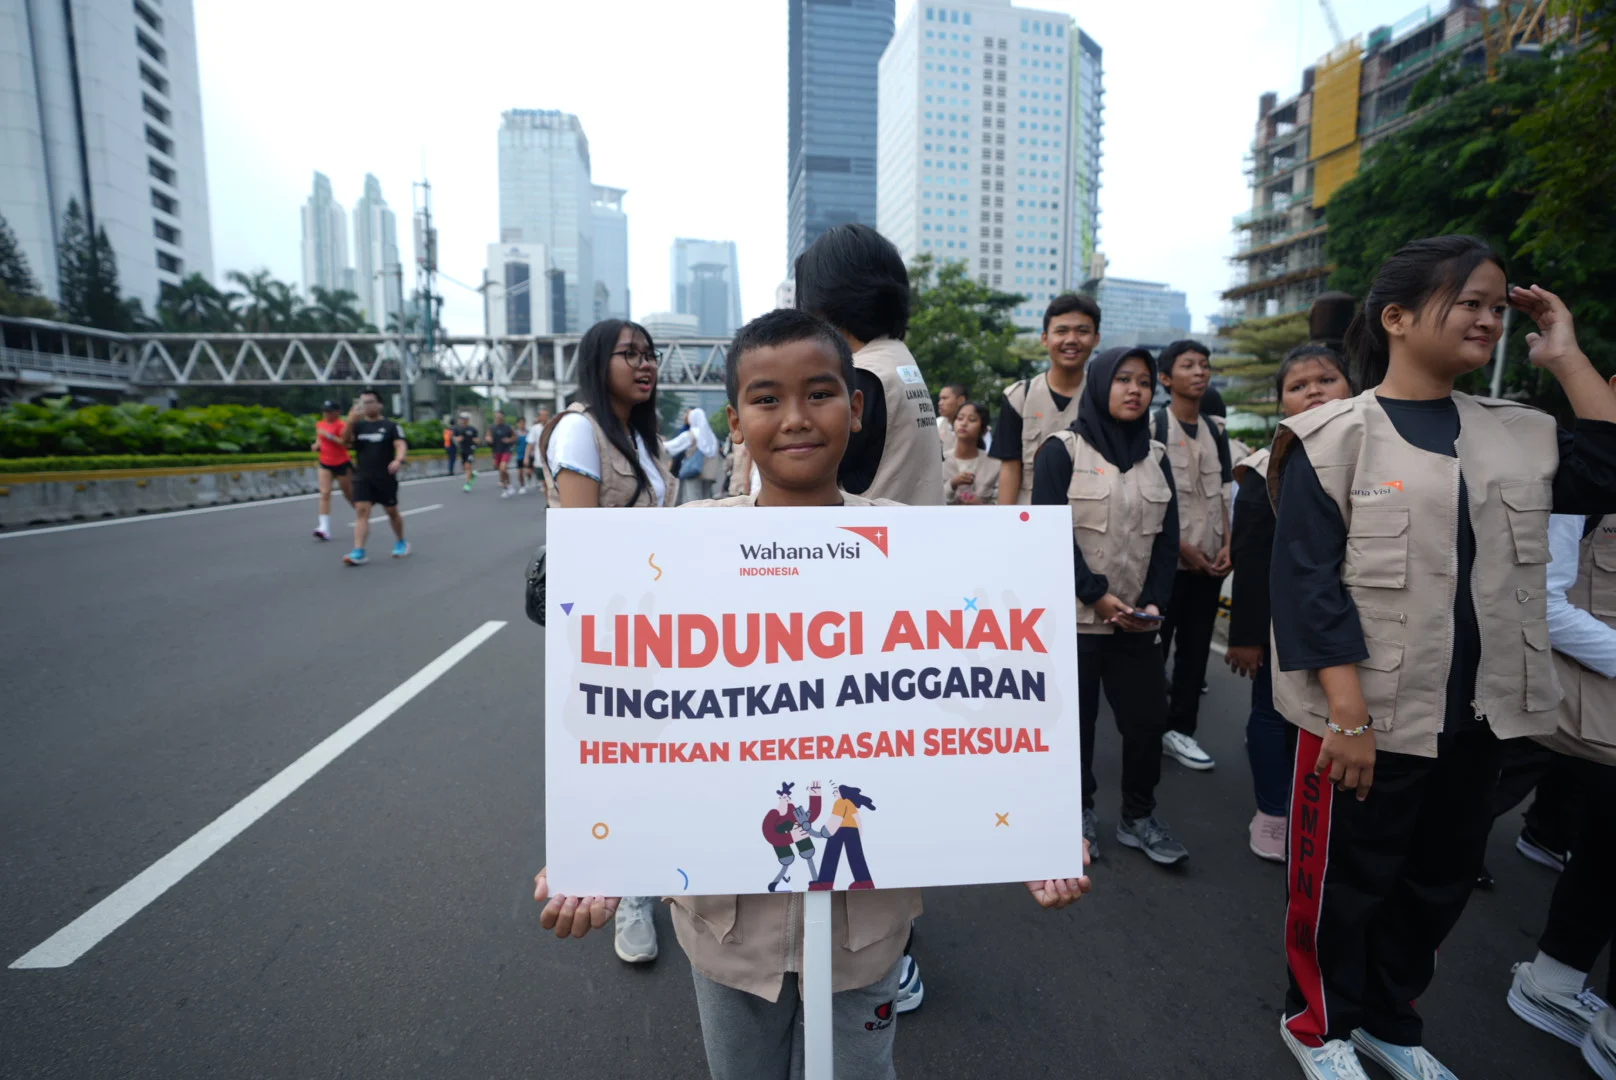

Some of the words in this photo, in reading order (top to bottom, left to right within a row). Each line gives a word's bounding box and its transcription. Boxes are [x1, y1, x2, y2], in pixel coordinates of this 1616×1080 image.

[1373, 487, 1391, 495] Visi
[740, 543, 823, 560] Wahana
[826, 542, 860, 559] Visi
[739, 567, 799, 576] INDONESIA
[581, 612, 863, 668] LINDUNGI
[881, 608, 1048, 654] ANAK
[579, 680, 825, 719] TINGKATKAN
[836, 667, 1046, 708] ANGGARAN
[580, 740, 730, 764] HENTIKAN
[740, 730, 915, 761] KEKERASAN
[923, 728, 1050, 757] SEKSUAL
[1298, 773, 1320, 899] SMPN
